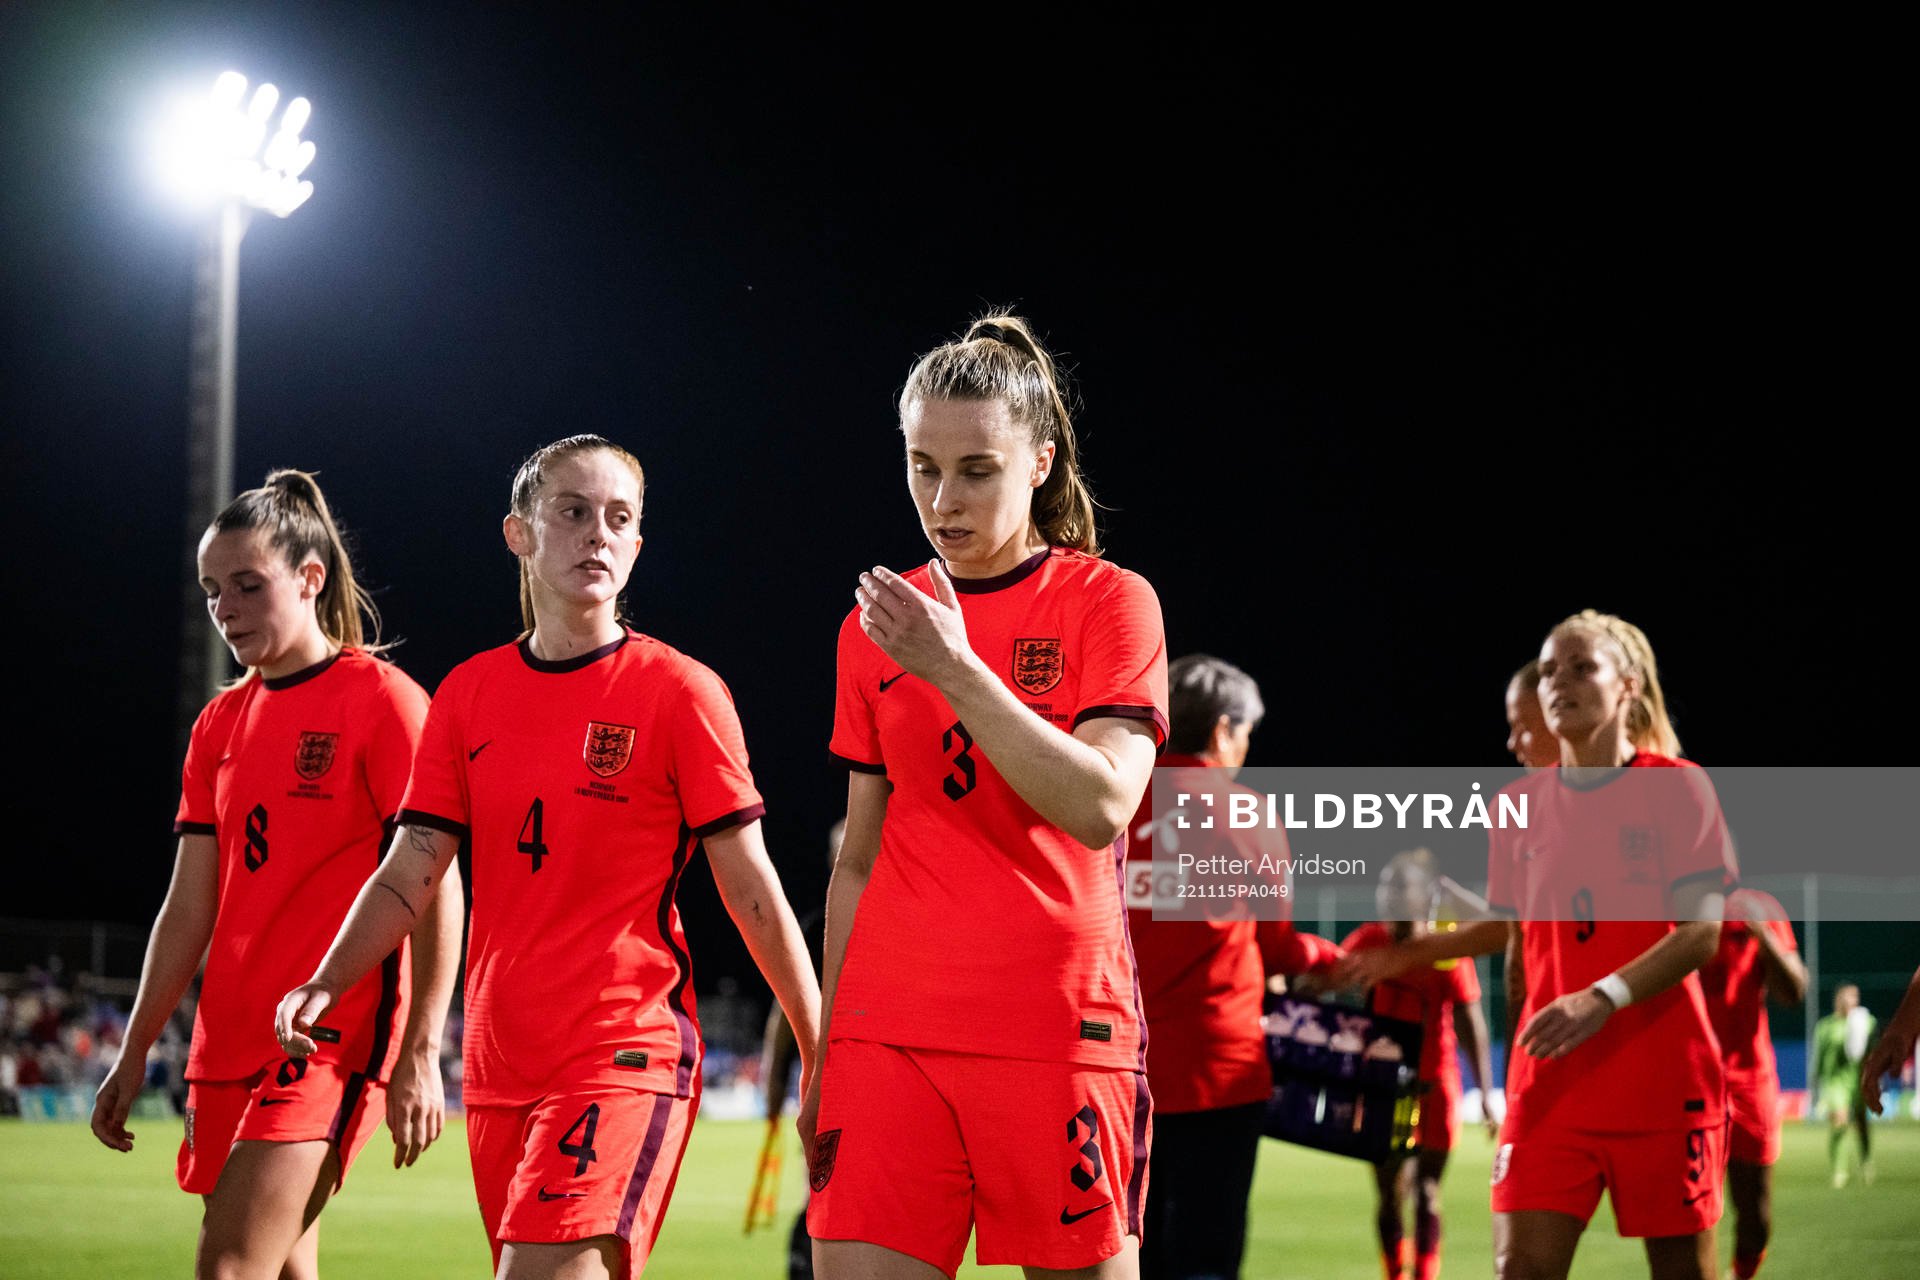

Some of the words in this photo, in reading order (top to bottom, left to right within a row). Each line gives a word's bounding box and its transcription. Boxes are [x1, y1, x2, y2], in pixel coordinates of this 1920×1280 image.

[942, 720, 976, 801] 3
[244, 803, 268, 873] 8
[517, 796, 549, 874] 4
[1571, 887, 1595, 943] 9
[557, 1102, 601, 1179] 4
[1066, 1105, 1102, 1192] 3
